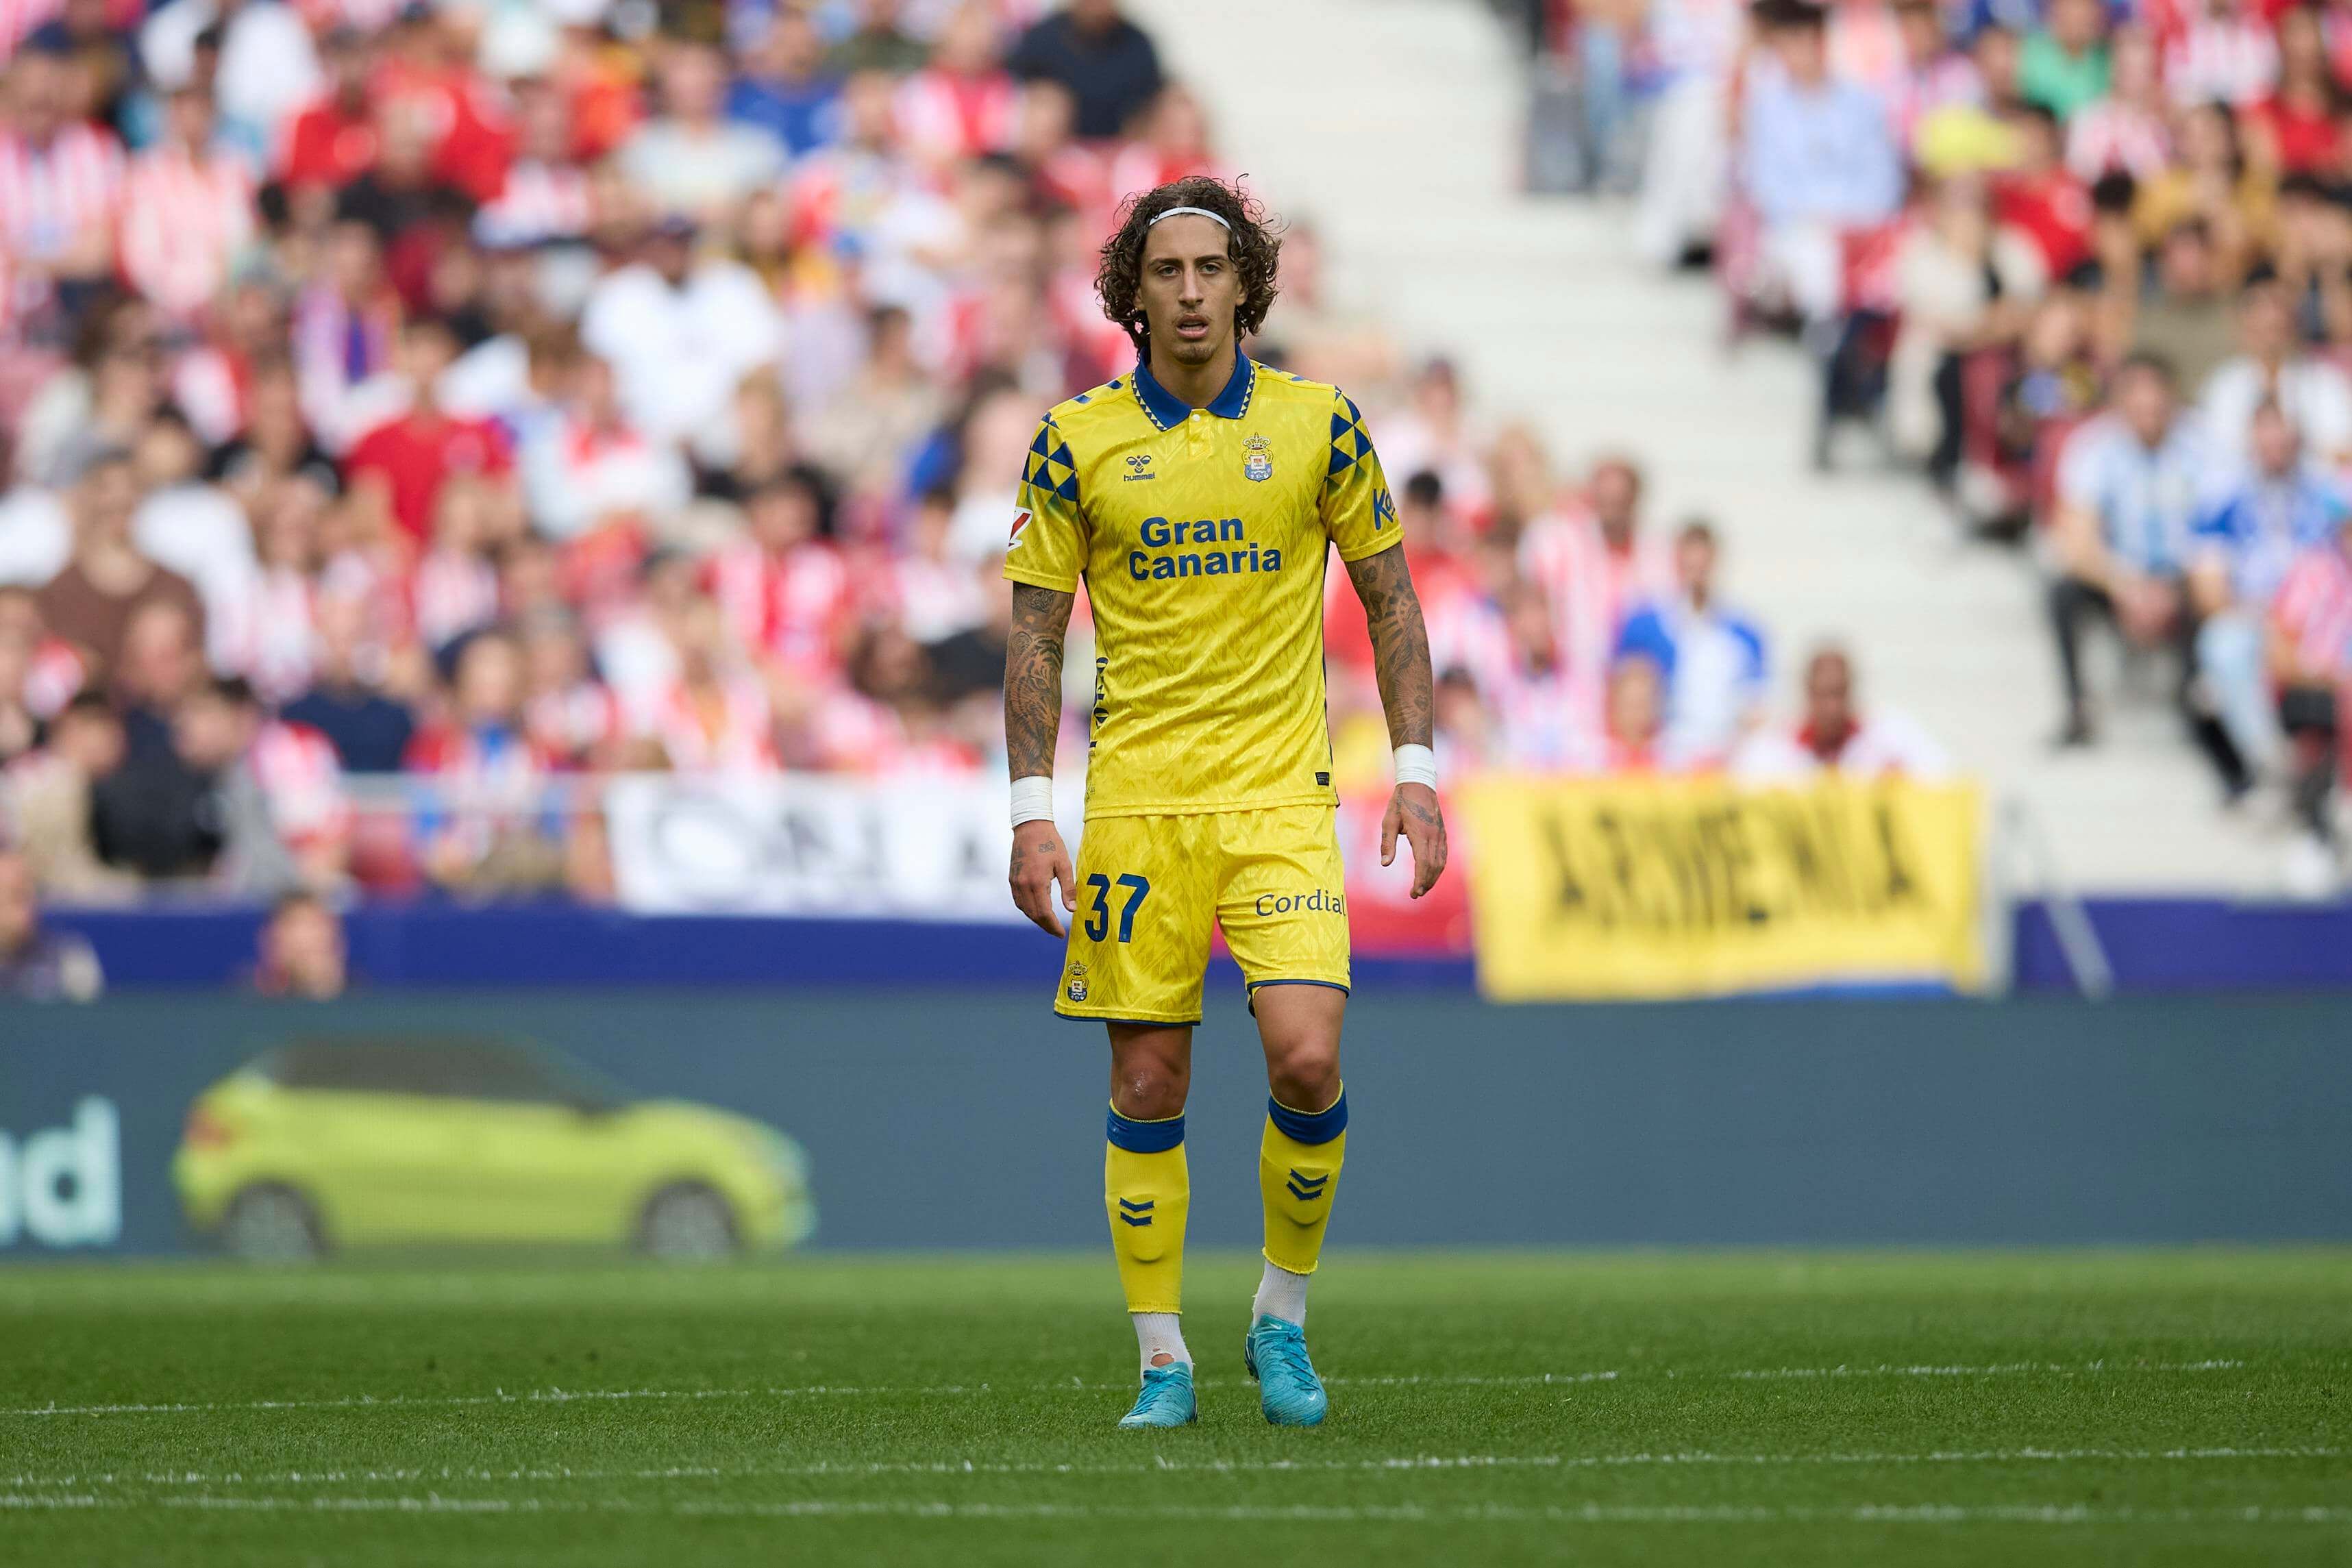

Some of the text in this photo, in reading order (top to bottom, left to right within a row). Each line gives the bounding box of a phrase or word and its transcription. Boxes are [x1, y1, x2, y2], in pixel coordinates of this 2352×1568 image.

[1124, 471, 1155, 482] hummel
[1140, 517, 1243, 548] Gran
[1129, 543, 1282, 581] Canaria
[1085, 873, 1151, 943] 37
[1256, 888, 1346, 917] Cordial
